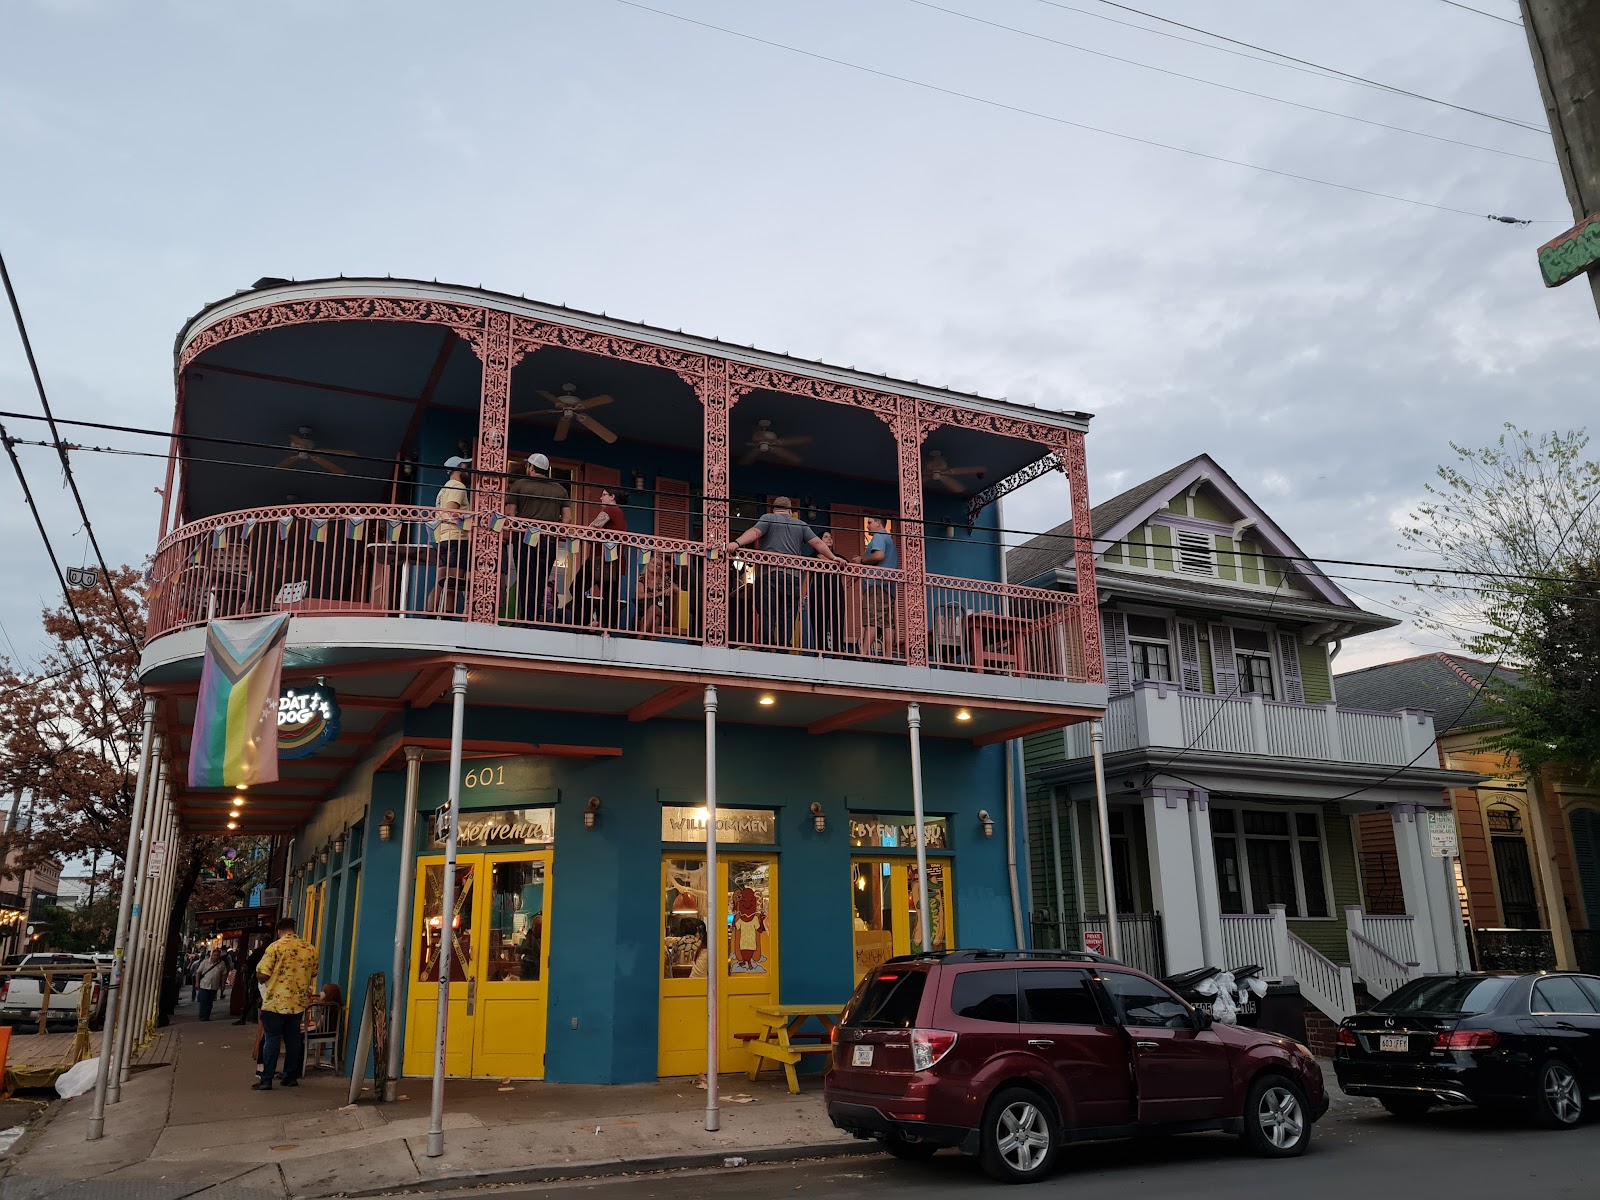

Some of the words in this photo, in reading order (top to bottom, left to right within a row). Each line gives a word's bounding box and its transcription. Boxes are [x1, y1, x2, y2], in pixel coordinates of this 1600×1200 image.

[279, 695, 309, 710] DAT
[278, 709, 313, 725] DOG
[465, 766, 504, 788] 601
[669, 818, 768, 832] WILLOMMEN
[1428, 813, 1436, 822] 2
[457, 821, 544, 841] ienvenue
[858, 823, 894, 838] BYEN
